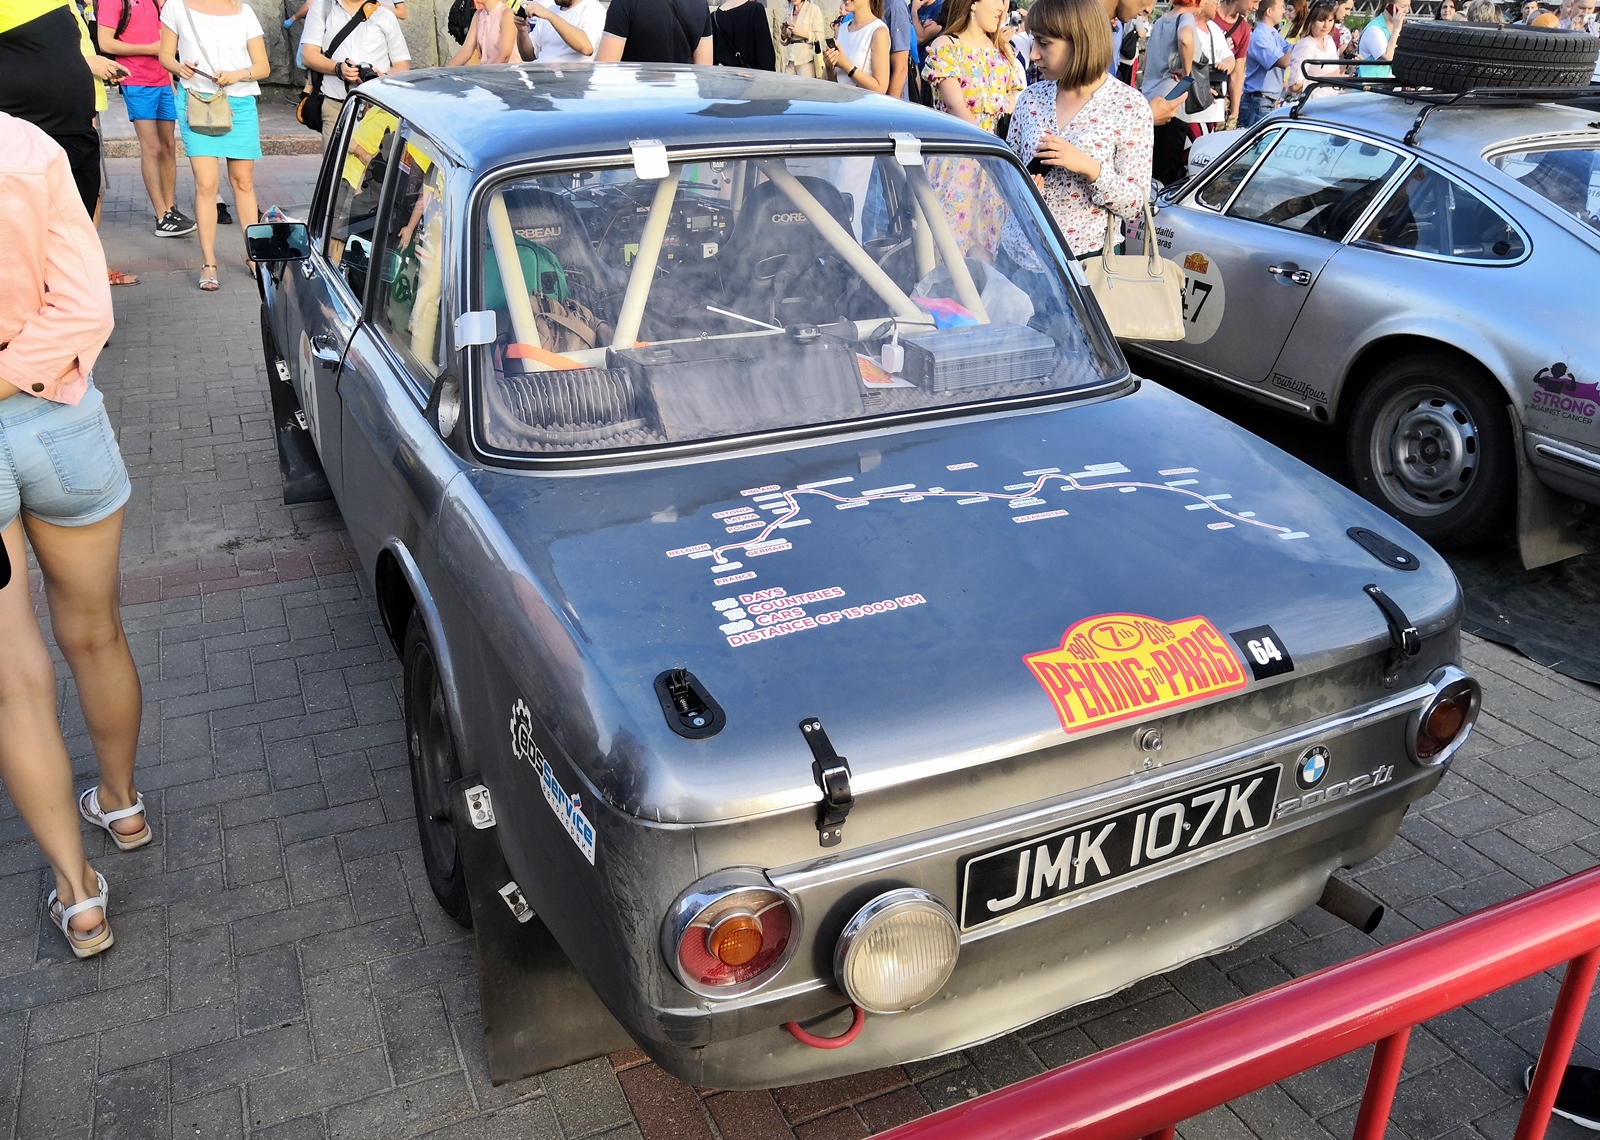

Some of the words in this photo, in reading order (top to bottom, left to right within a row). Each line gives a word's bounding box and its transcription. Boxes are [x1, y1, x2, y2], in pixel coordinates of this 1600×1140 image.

[771, 212, 809, 223] CORB
[514, 226, 562, 239] RBEAU
[1532, 390, 1596, 417] STRONG
[1530, 403, 1561, 417] AGAINST
[1561, 411, 1593, 425] CANCER
[741, 484, 779, 496] FINLAND
[713, 507, 752, 519] ESTONIA
[725, 513, 758, 524] LATVIA
[727, 521, 765, 533] POLAND
[668, 544, 709, 556] BELGIUM
[747, 543, 791, 556] GERMANY
[715, 572, 755, 585] FRANCE
[740, 587, 784, 603] DAYS
[748, 587, 843, 614] COUNTRIES
[729, 618, 816, 646] DISTANCE
[816, 612, 841, 624] OF
[897, 594, 924, 607] KM
[756, 607, 804, 625] CARS
[1066, 632, 1101, 661] 1907
[1097, 625, 1135, 647] 7th
[1133, 620, 1177, 645] 2019
[1149, 623, 1241, 696] PARIS
[1246, 636, 1283, 665] 64
[1146, 666, 1166, 686] TO
[1033, 656, 1160, 723] PEKING
[1300, 747, 1329, 766] BMW
[986, 821, 1117, 912] JMK
[1130, 776, 1263, 867] 107K
